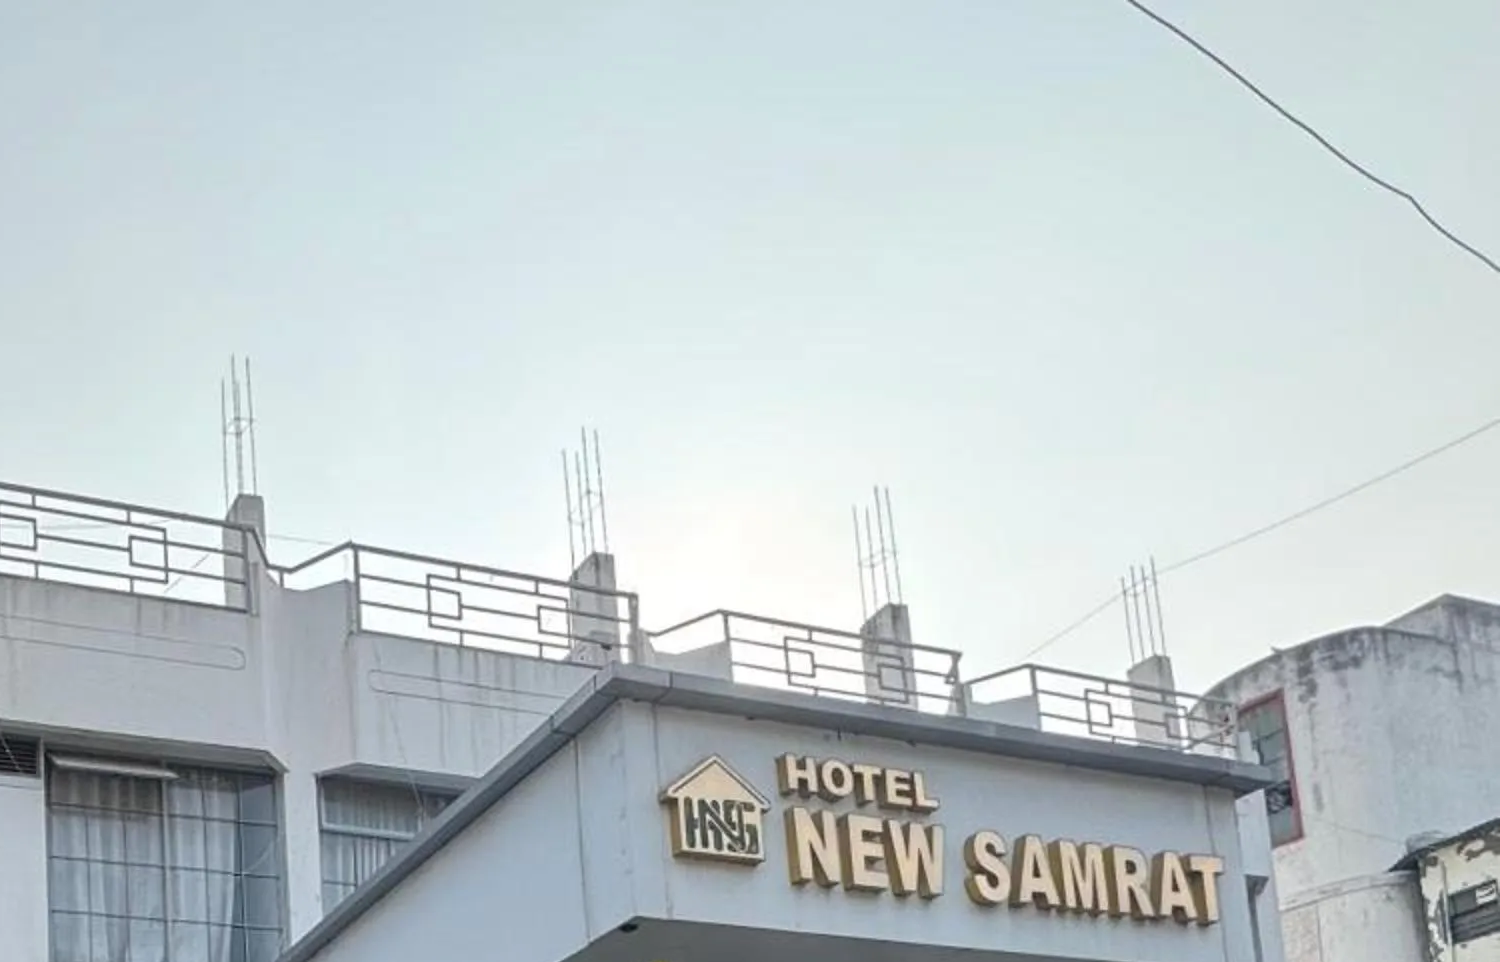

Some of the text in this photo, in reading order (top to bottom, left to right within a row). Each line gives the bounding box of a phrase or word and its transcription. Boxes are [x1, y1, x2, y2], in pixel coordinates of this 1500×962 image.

[777, 752, 941, 813] HOTEL
[784, 806, 1224, 925] NEW SAMRAT
